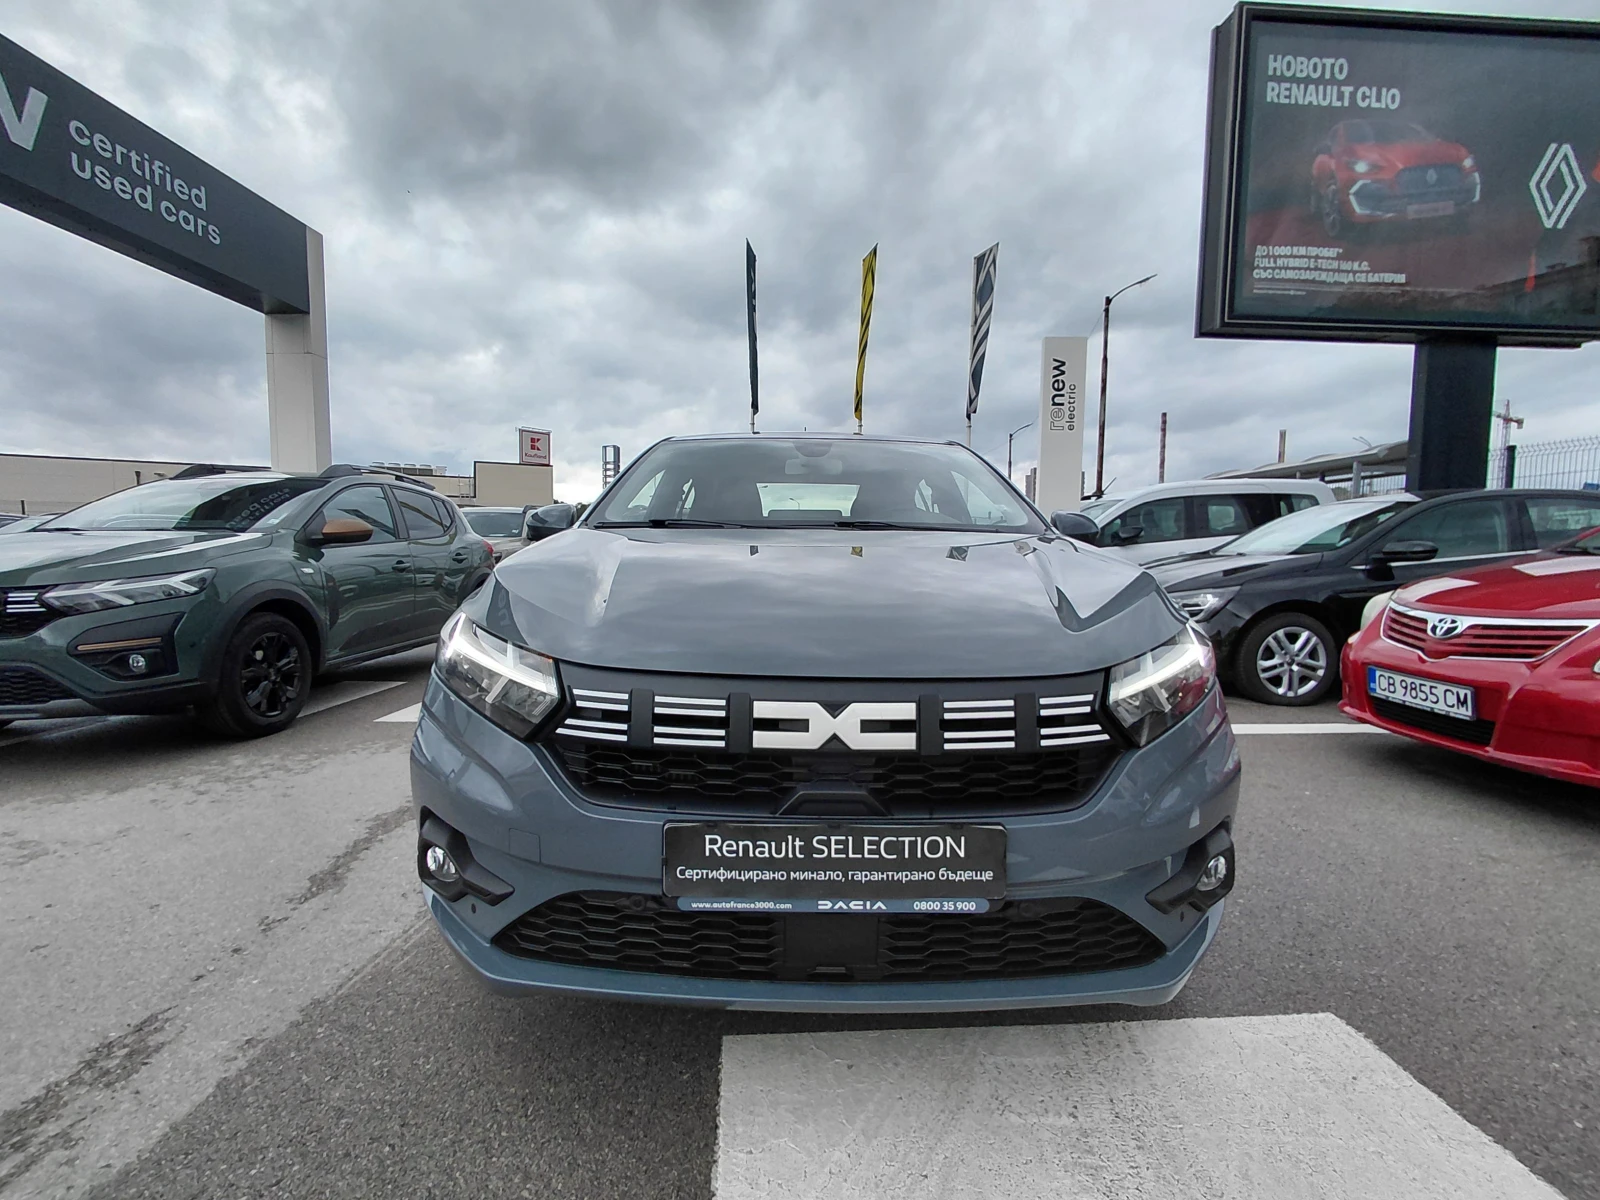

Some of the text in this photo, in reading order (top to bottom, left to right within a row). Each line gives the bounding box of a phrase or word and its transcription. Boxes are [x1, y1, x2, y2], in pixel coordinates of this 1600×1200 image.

[1267, 54, 1348, 80] НОВОТО
[1266, 81, 1401, 110] RENAULT CLIO
[68, 119, 207, 211] certified
[70, 151, 221, 245] used cars
[1254, 257, 1276, 267] FULL
[1277, 257, 1309, 268] HYBRID
[1309, 258, 1339, 270] E-TECH
[1050, 358, 1066, 431] renew
[1065, 383, 1076, 431] electric
[524, 452, 547, 460] Kaufland
[1377, 673, 1469, 712] CB 9855 CM
[704, 834, 965, 859] Renault SELECTION
[676, 866, 994, 883] Сертифицирано минало, гарантирано бъдеще
[691, 900, 976, 911] www.autofrance3000.com DACIA 0800 35 900
